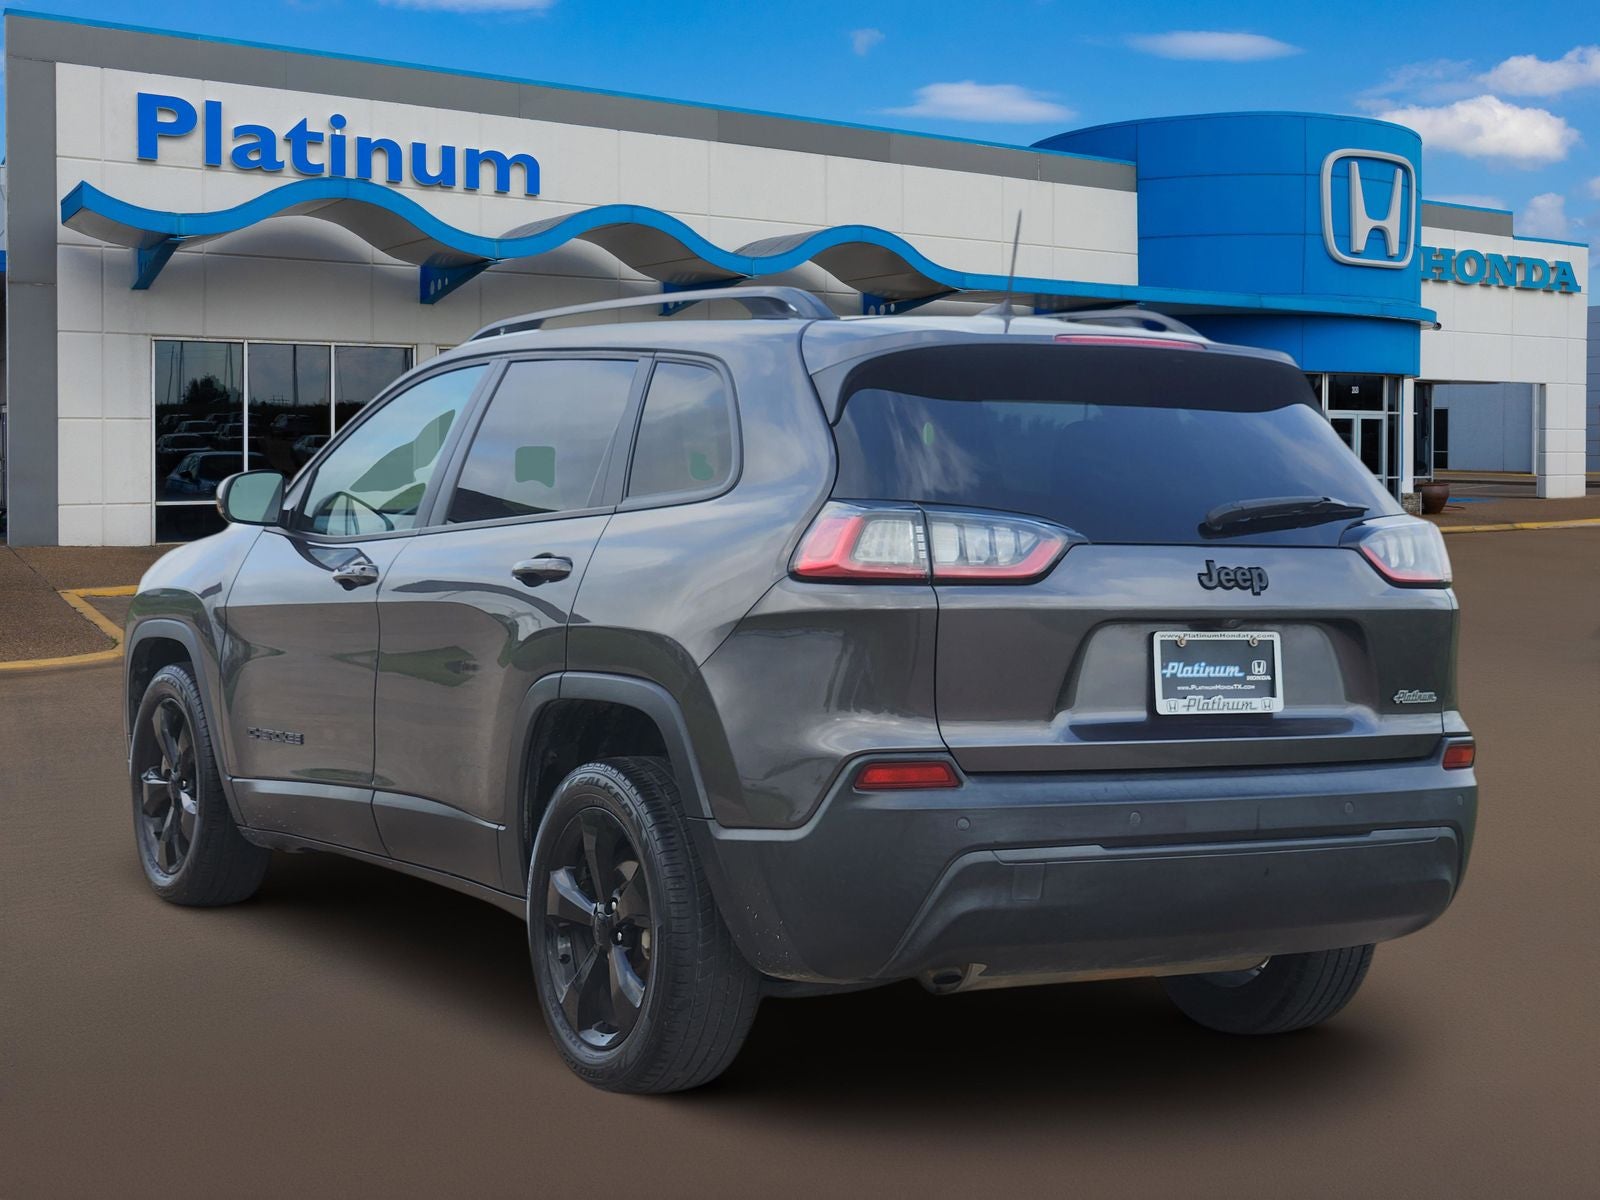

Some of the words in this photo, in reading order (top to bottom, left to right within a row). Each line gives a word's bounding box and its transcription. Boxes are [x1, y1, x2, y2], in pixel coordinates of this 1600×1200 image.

[137, 92, 541, 196] Platinum
[1420, 246, 1582, 293] HONDA
[1197, 559, 1269, 596] Jeep
[1162, 661, 1245, 678] Platinum
[1182, 695, 1258, 712] Platinum
